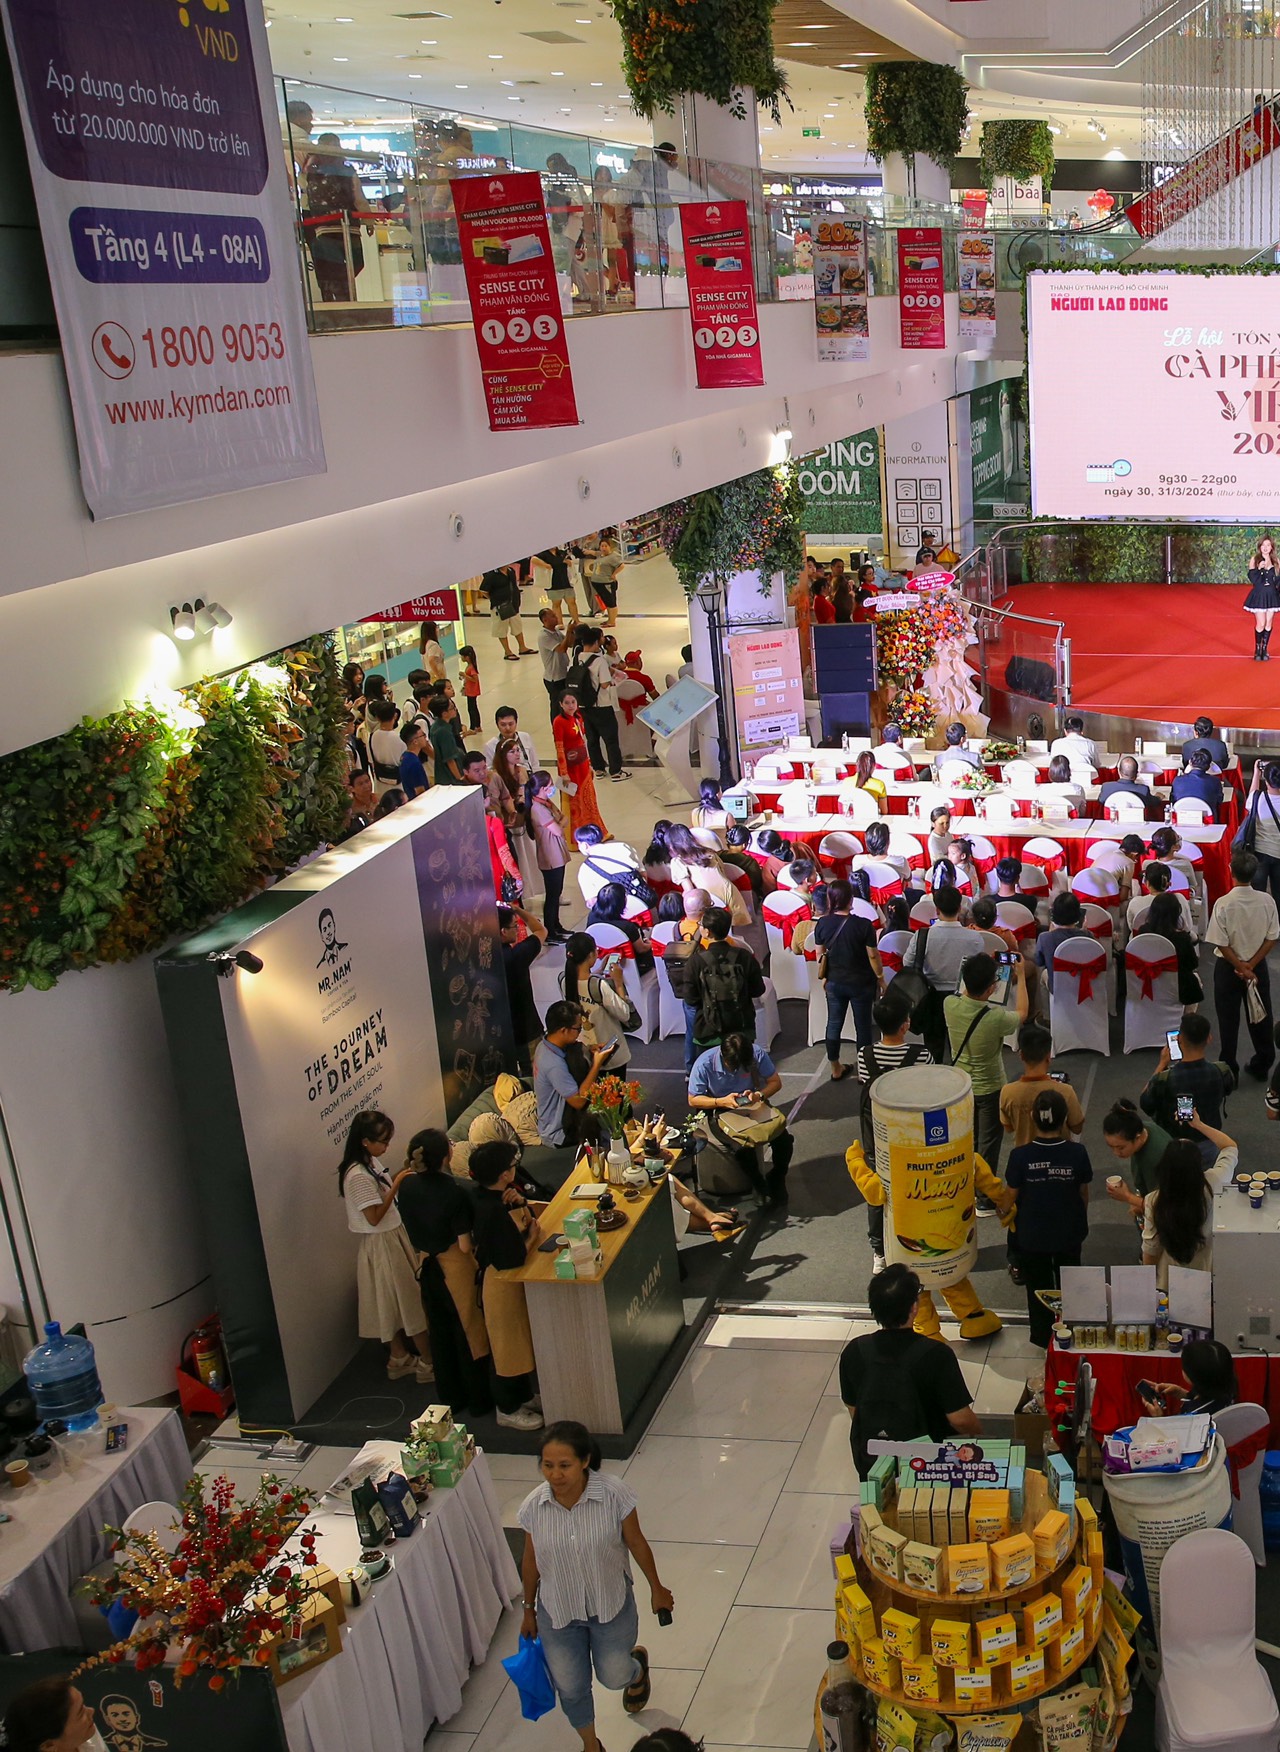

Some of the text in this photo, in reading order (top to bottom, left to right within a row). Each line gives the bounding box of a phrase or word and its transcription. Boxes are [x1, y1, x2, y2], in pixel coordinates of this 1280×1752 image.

[195, 24, 239, 62] VND
[46, 59, 220, 116] Áp dụng cho hóa đơn
[52, 111, 250, 158] từ 20.000.000 VND trở lên
[1014, 184, 1040, 199] baa
[964, 214, 983, 226] tặng
[819, 222, 856, 242] 20%
[85, 224, 263, 271] Tầng 4 (L4 08A)
[479, 278, 545, 294] SENSE CITY
[480, 296, 506, 307] PHẠM
[696, 291, 748, 302] SENSE CITY
[1098, 298, 1125, 311] LAO
[489, 321, 551, 339] 1 2 3
[721, 329, 752, 343] 2 3
[1163, 326, 1193, 347] Lễ
[1197, 326, 1223, 347] hội
[142, 322, 286, 370] 1800 9053
[1164, 349, 1212, 379] CÀ
[505, 385, 526, 393] SENSE
[528, 383, 544, 391] CITY
[105, 382, 292, 427] www.kymdan.com
[886, 456, 947, 465] INFORMATION
[1158, 474, 1237, 486] 9g30 22g00
[1104, 487, 1214, 498] ngày 30, 31/3/2024
[429, 596, 443, 606] RA
[412, 607, 446, 617] Way out
[318, 960, 351, 995] MR.NAM
[322, 1004, 341, 1024] Bamboo
[341, 993, 358, 1010] Capital
[304, 1008, 383, 1082] THE JOURNEY
[308, 1026, 388, 1102] OF DREAM
[320, 1061, 384, 1122] FROM THE VIET SOUL
[907, 1153, 965, 1171] FRUIT COFFEE
[1048, 1168, 1072, 1176] MORE
[906, 1171, 969, 1200] Mango
[917, 1471, 949, 1480] Không
[965, 1471, 975, 1480] Bị
[977, 1472, 997, 1480] Say
[926, 1463, 992, 1471] MEET MORE
